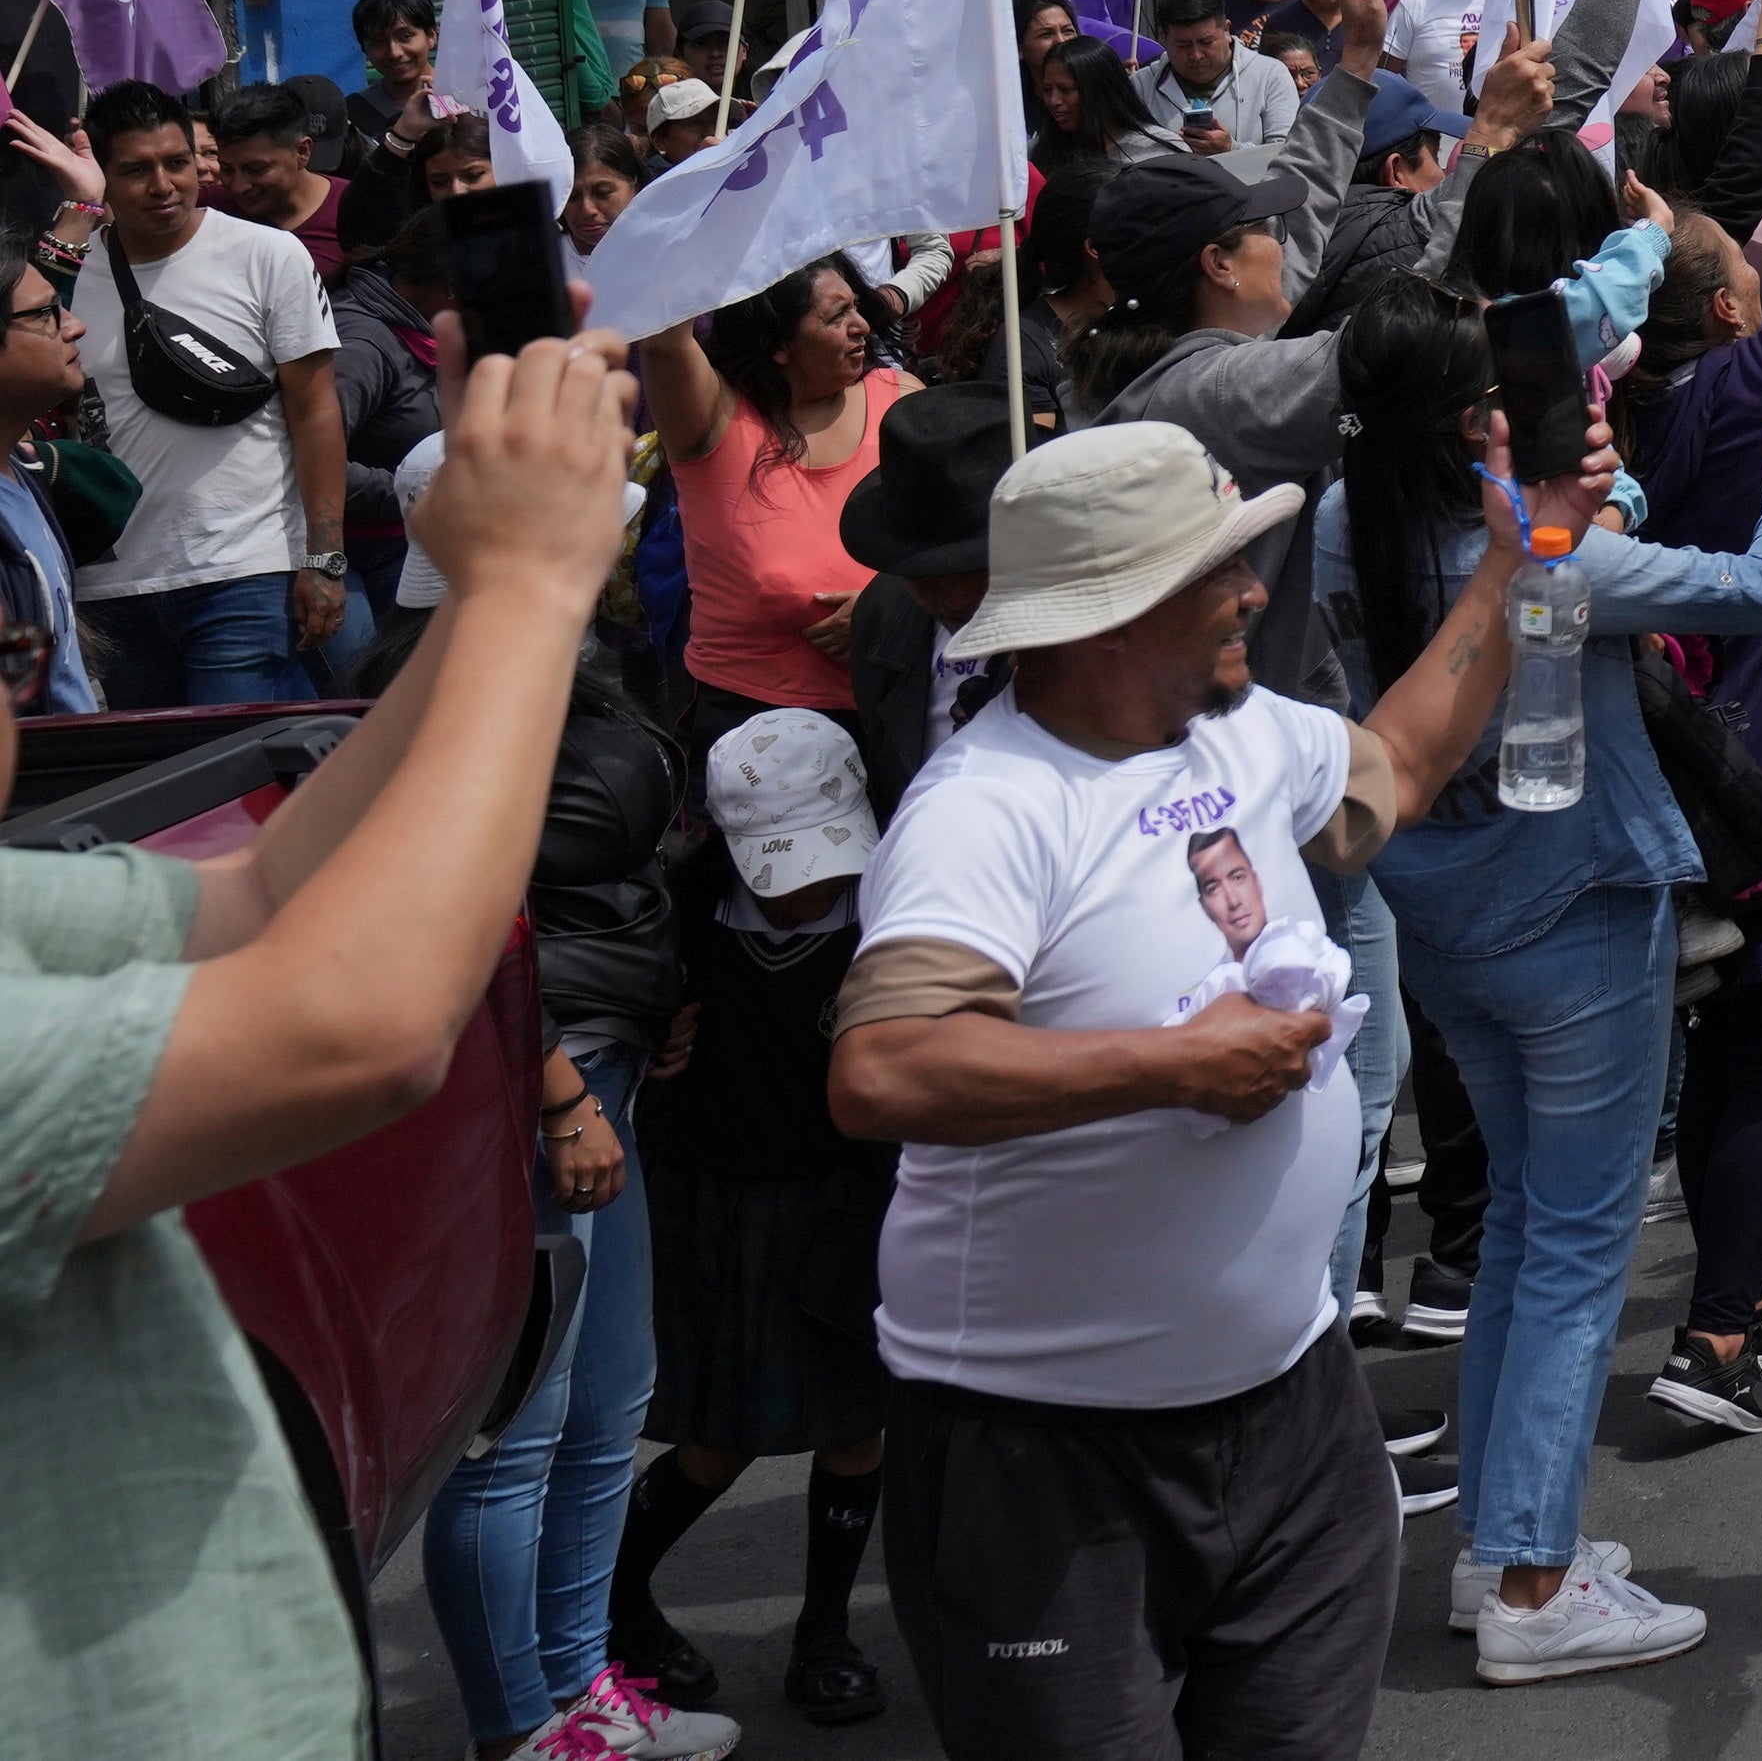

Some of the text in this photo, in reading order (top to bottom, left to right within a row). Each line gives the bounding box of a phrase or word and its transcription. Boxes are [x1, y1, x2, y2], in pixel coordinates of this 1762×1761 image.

[169, 333, 237, 374] NIKE
[738, 761, 762, 788] LOVE
[761, 837, 794, 854] LOVE
[987, 1638, 1070, 1659] FUTBOL
